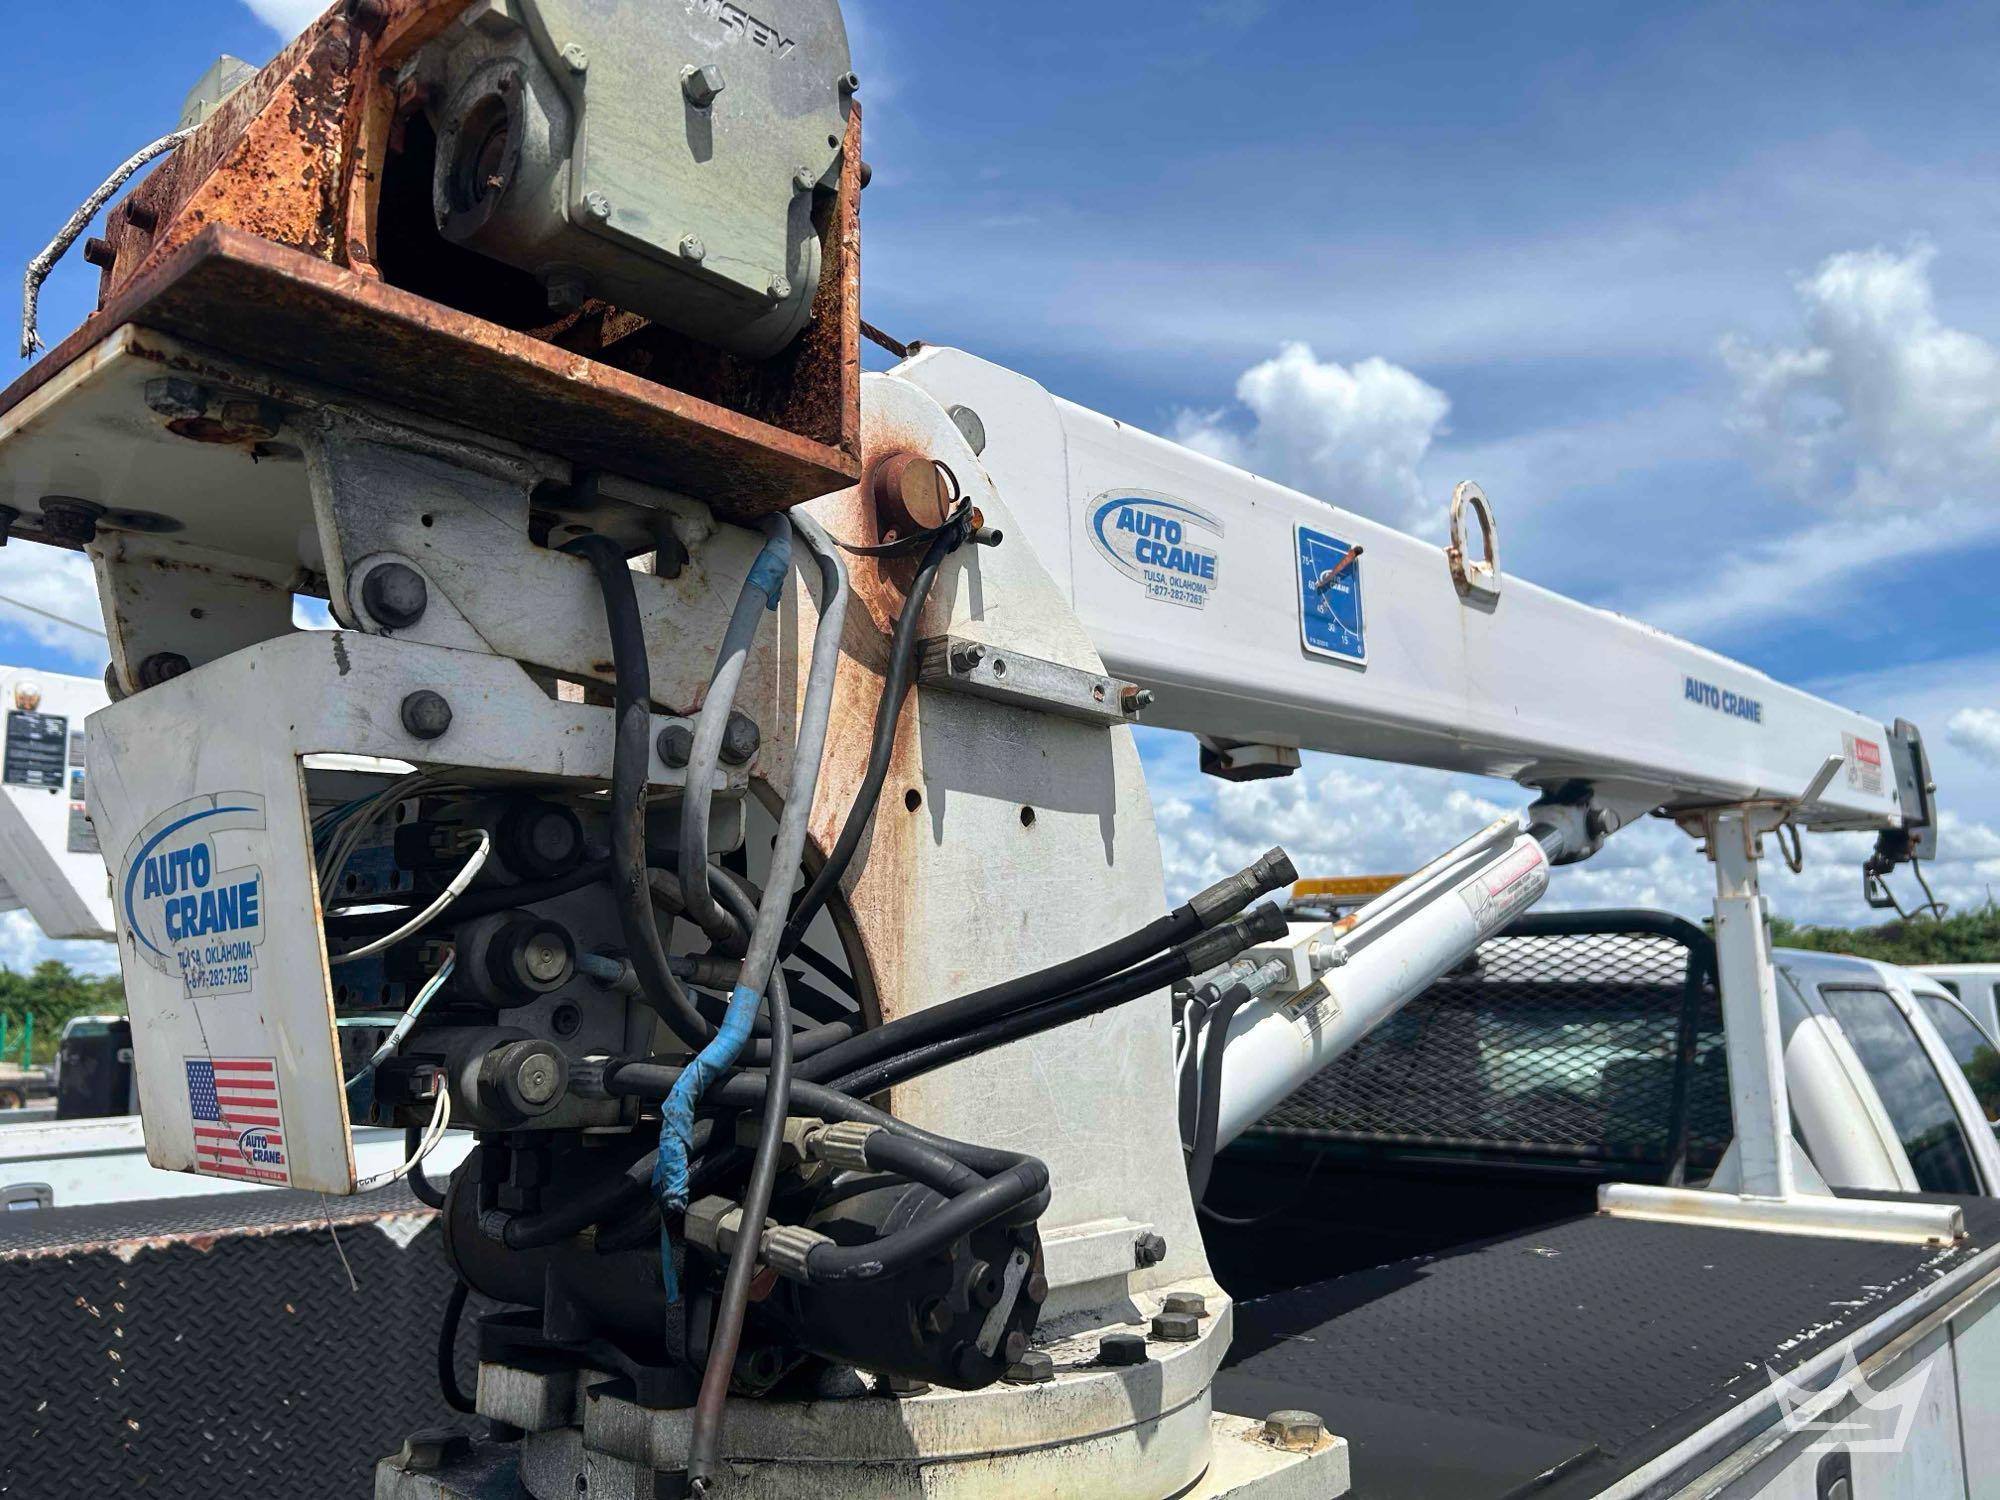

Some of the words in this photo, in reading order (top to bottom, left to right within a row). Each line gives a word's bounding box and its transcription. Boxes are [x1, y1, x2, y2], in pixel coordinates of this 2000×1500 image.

[688, 0, 796, 58] MSEY
[1116, 506, 1181, 545] AUTO
[1135, 538, 1215, 580] CRANE
[1144, 569, 1168, 585] TULSA,
[1169, 576, 1207, 594] OKLAHOMA
[1147, 583, 1203, 605] 1-877-282-7263
[1685, 676, 1720, 710] AUTO
[1722, 689, 1761, 724] CRANE
[144, 843, 210, 900] AUTO
[165, 880, 259, 941] CRANE
[205, 941, 253, 964] OKLAHOMA
[391, 1033, 401, 1046] UP
[246, 1135, 268, 1149] AUTO
[253, 1149, 281, 1165] CRANE
